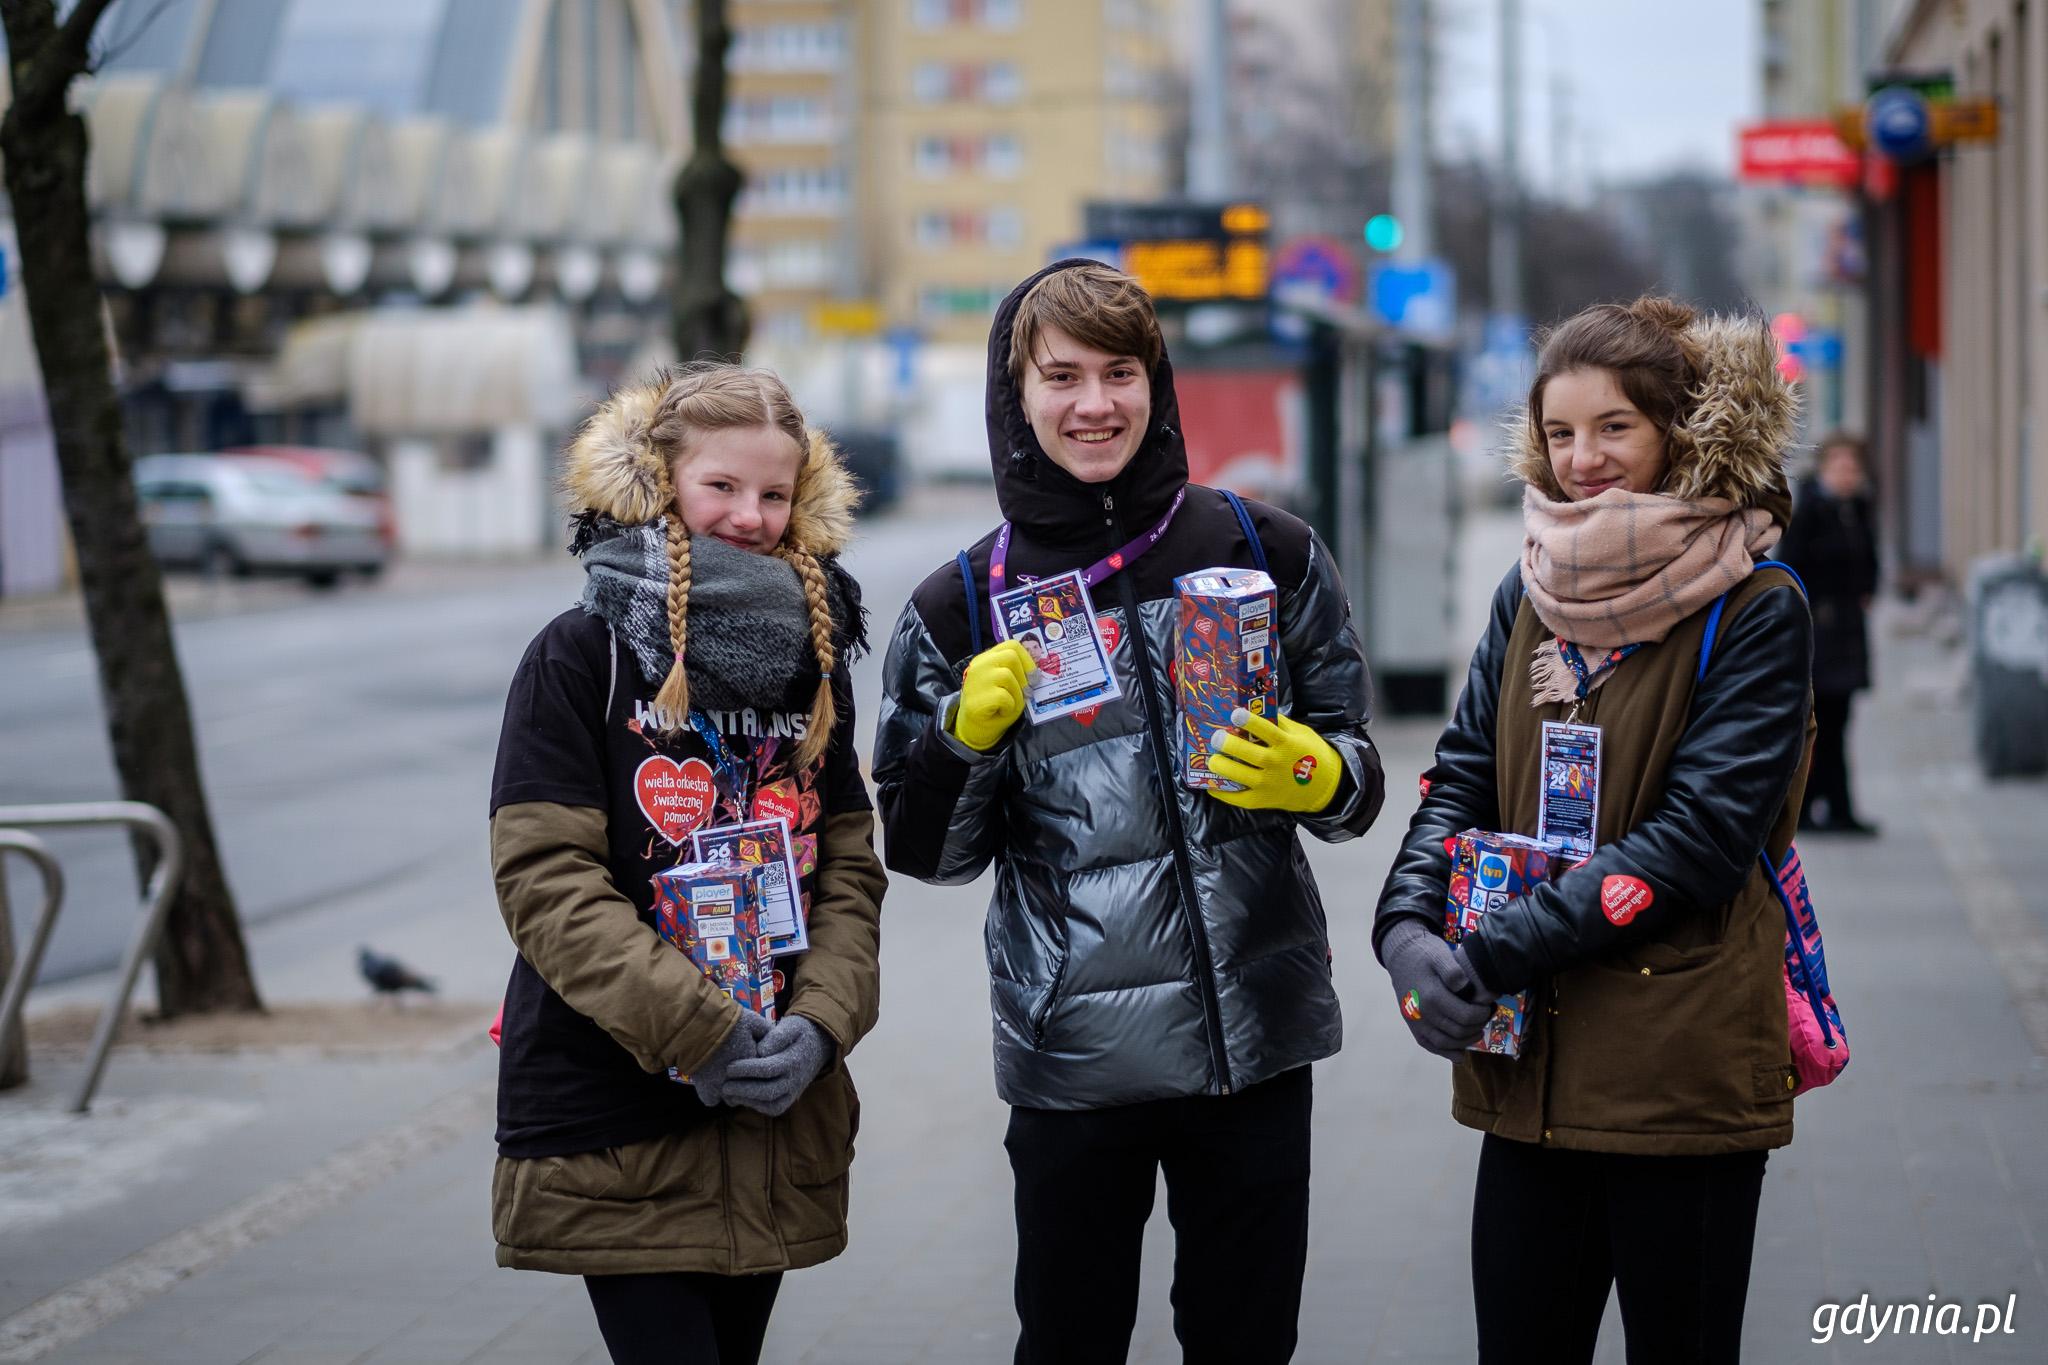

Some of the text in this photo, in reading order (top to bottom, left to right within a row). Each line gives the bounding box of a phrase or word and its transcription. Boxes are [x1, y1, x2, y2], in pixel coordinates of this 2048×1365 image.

[1008, 601, 1031, 628] 26
[1241, 601, 1268, 618] player
[644, 771, 709, 793] wielka orkiestra
[1550, 771, 1566, 788] 26
[653, 790, 704, 817] świątecznej
[758, 798, 775, 810] wielka
[706, 841, 731, 863] 26
[1482, 863, 1503, 880] tvn
[695, 887, 731, 901] player
